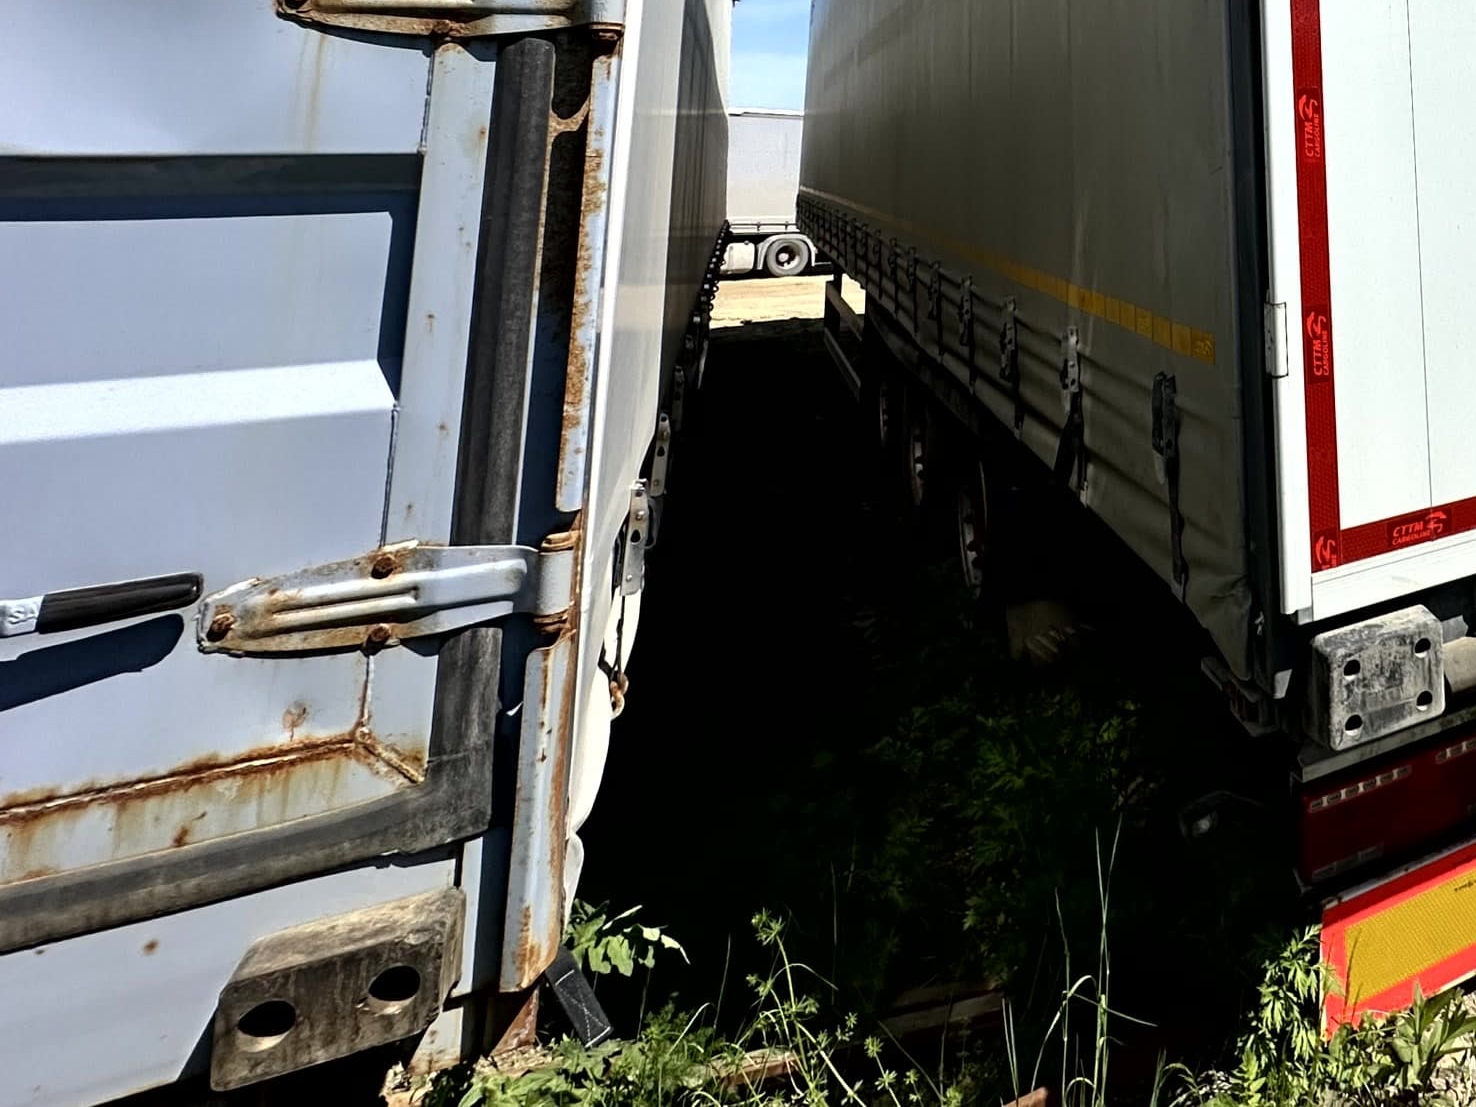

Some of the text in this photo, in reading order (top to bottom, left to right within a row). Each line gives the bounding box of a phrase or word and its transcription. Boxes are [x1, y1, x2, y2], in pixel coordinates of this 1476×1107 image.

[1305, 121, 1314, 157] CTTM
[1313, 339, 1322, 376] CTTM
[1393, 520, 1424, 536] CTTM
